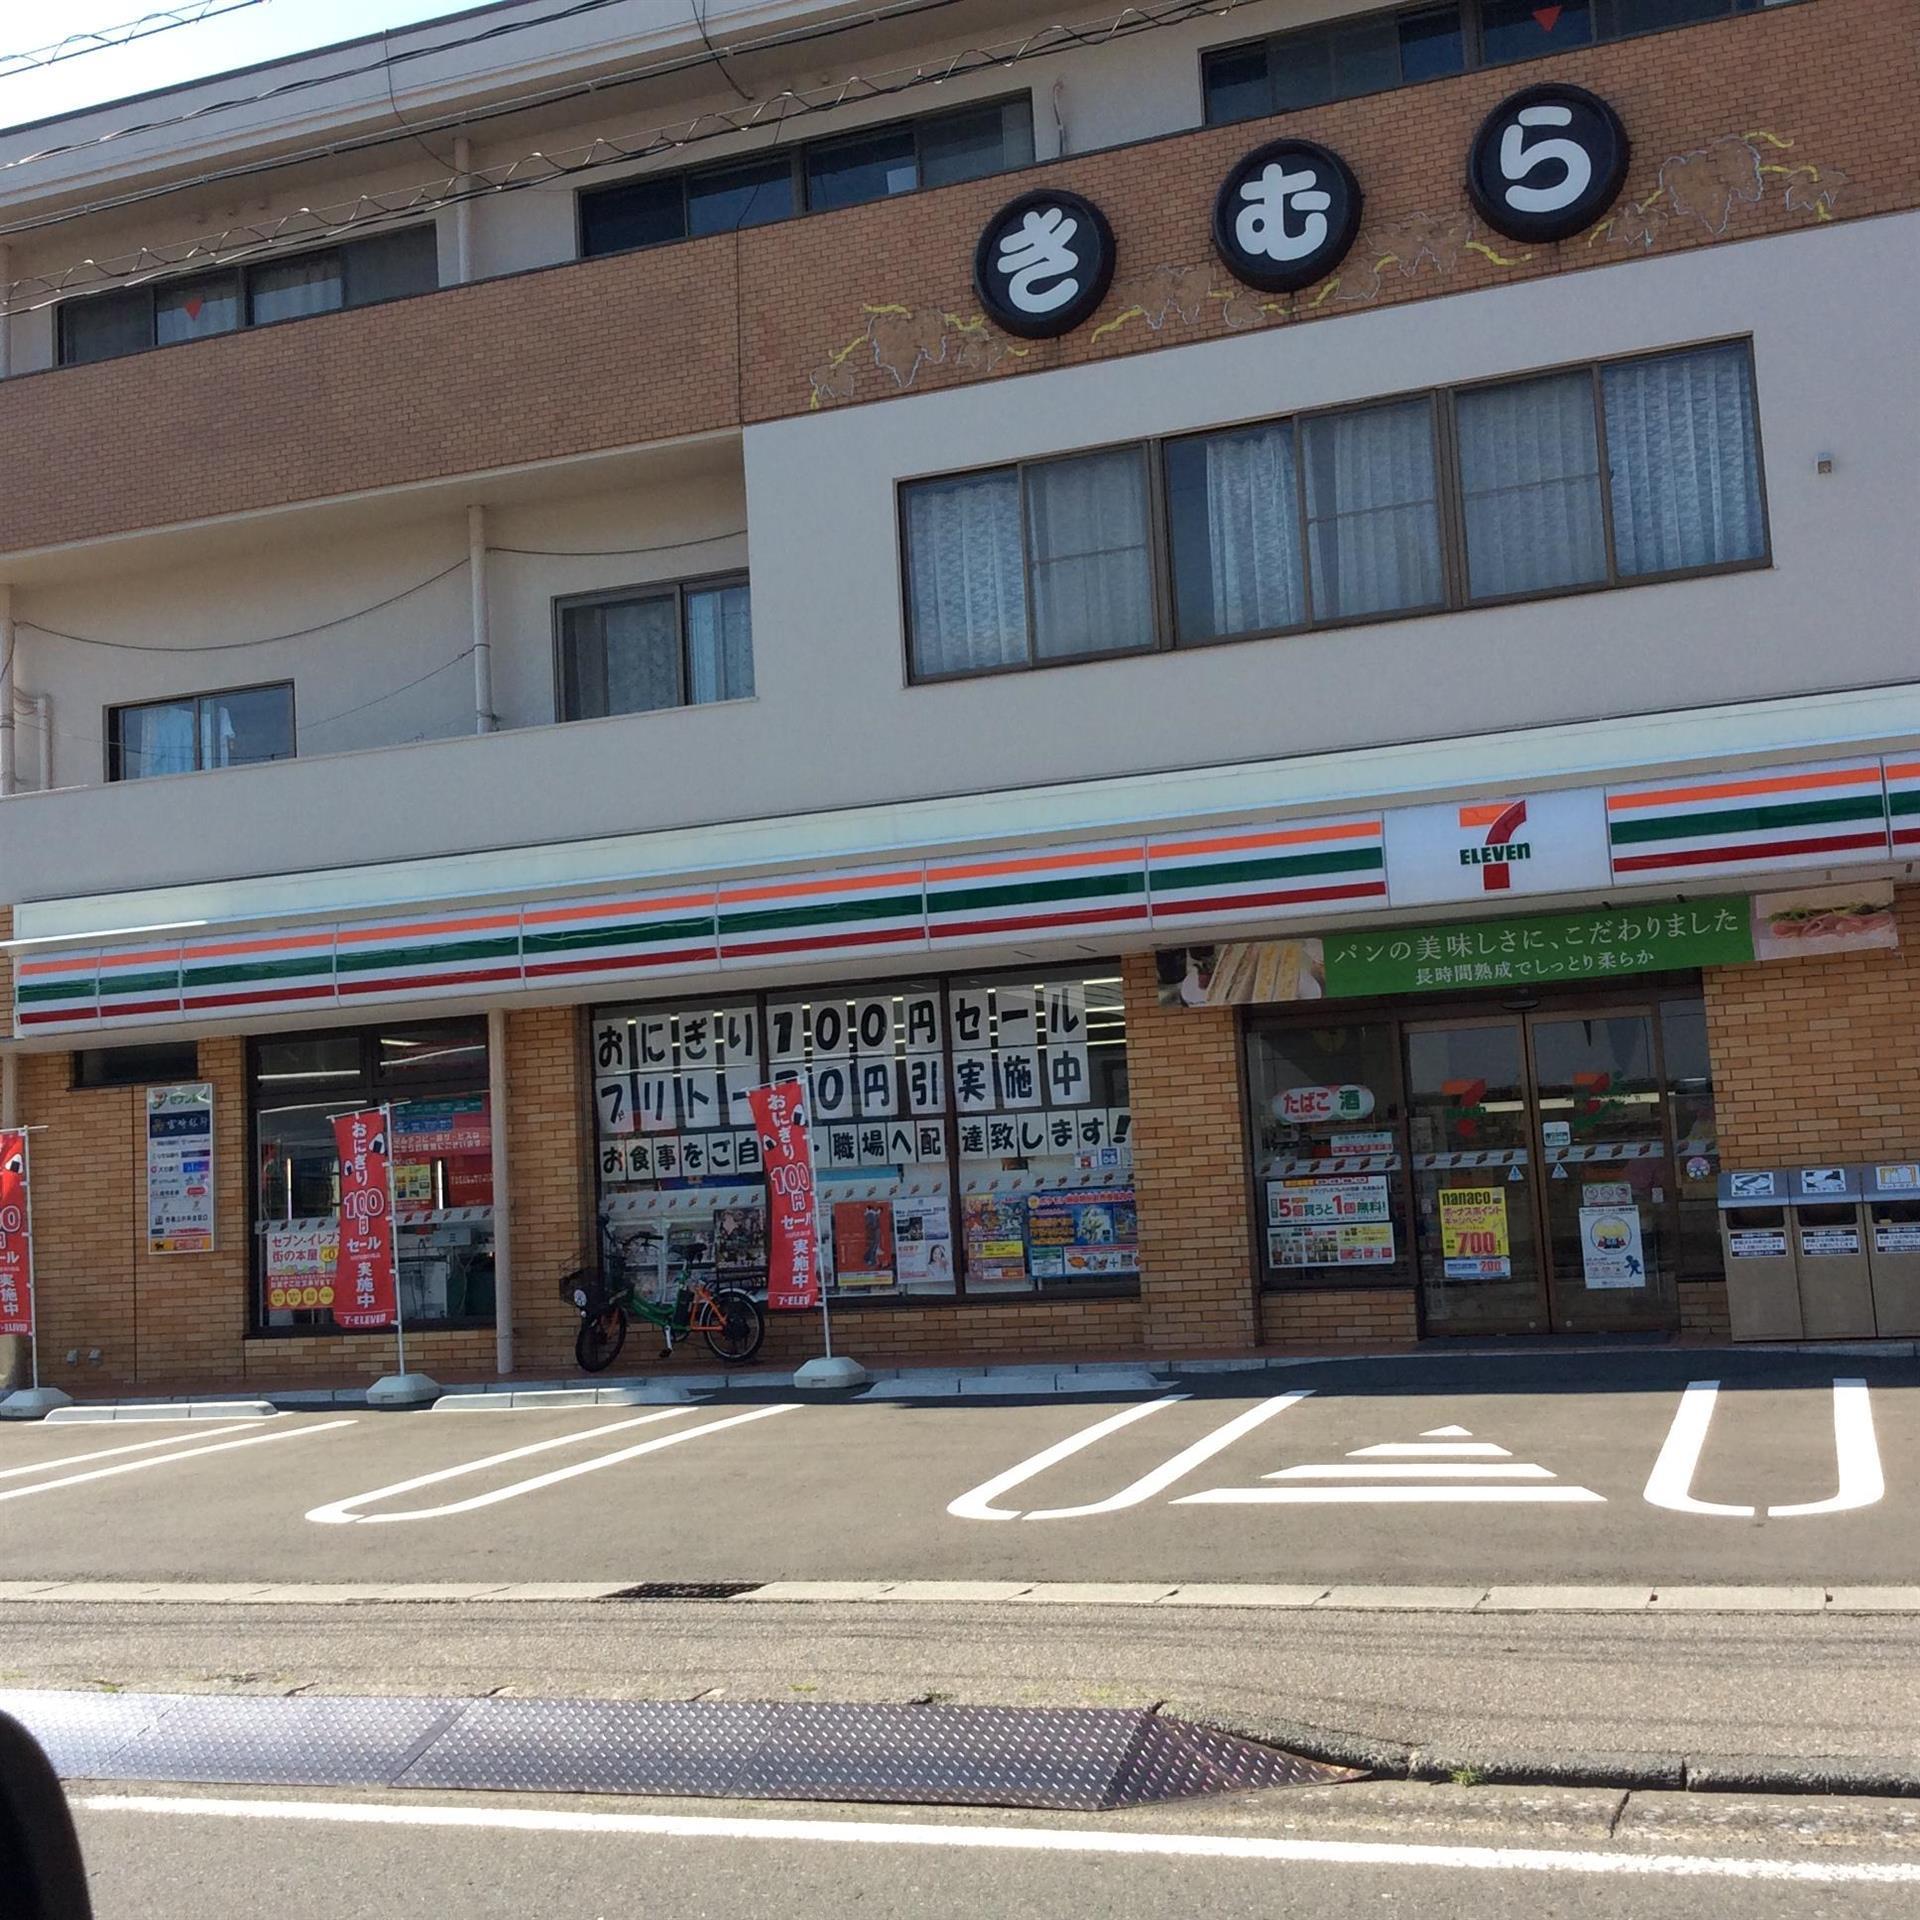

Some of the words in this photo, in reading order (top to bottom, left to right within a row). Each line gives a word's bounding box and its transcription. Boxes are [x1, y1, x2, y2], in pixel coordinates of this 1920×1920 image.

[1460, 800, 1526, 889] 7
[1335, 908, 1739, 963] パンの美味しさに、こだわりました
[1416, 949, 1655, 986] 長時間熟成でしっとり柔らか
[1284, 1092, 1330, 1114] たばこ
[1339, 1090, 1360, 1110] 酒
[768, 1095, 794, 1160] おにぎり
[352, 1122, 367, 1186] おにぎり
[771, 1162, 810, 1194] 100
[1442, 1191, 1491, 1206] nanaco
[347, 1236, 382, 1253] セール
[1456, 1231, 1497, 1254] 700
[792, 1239, 808, 1288] 実施中
[355, 1262, 375, 1308] 実施中
